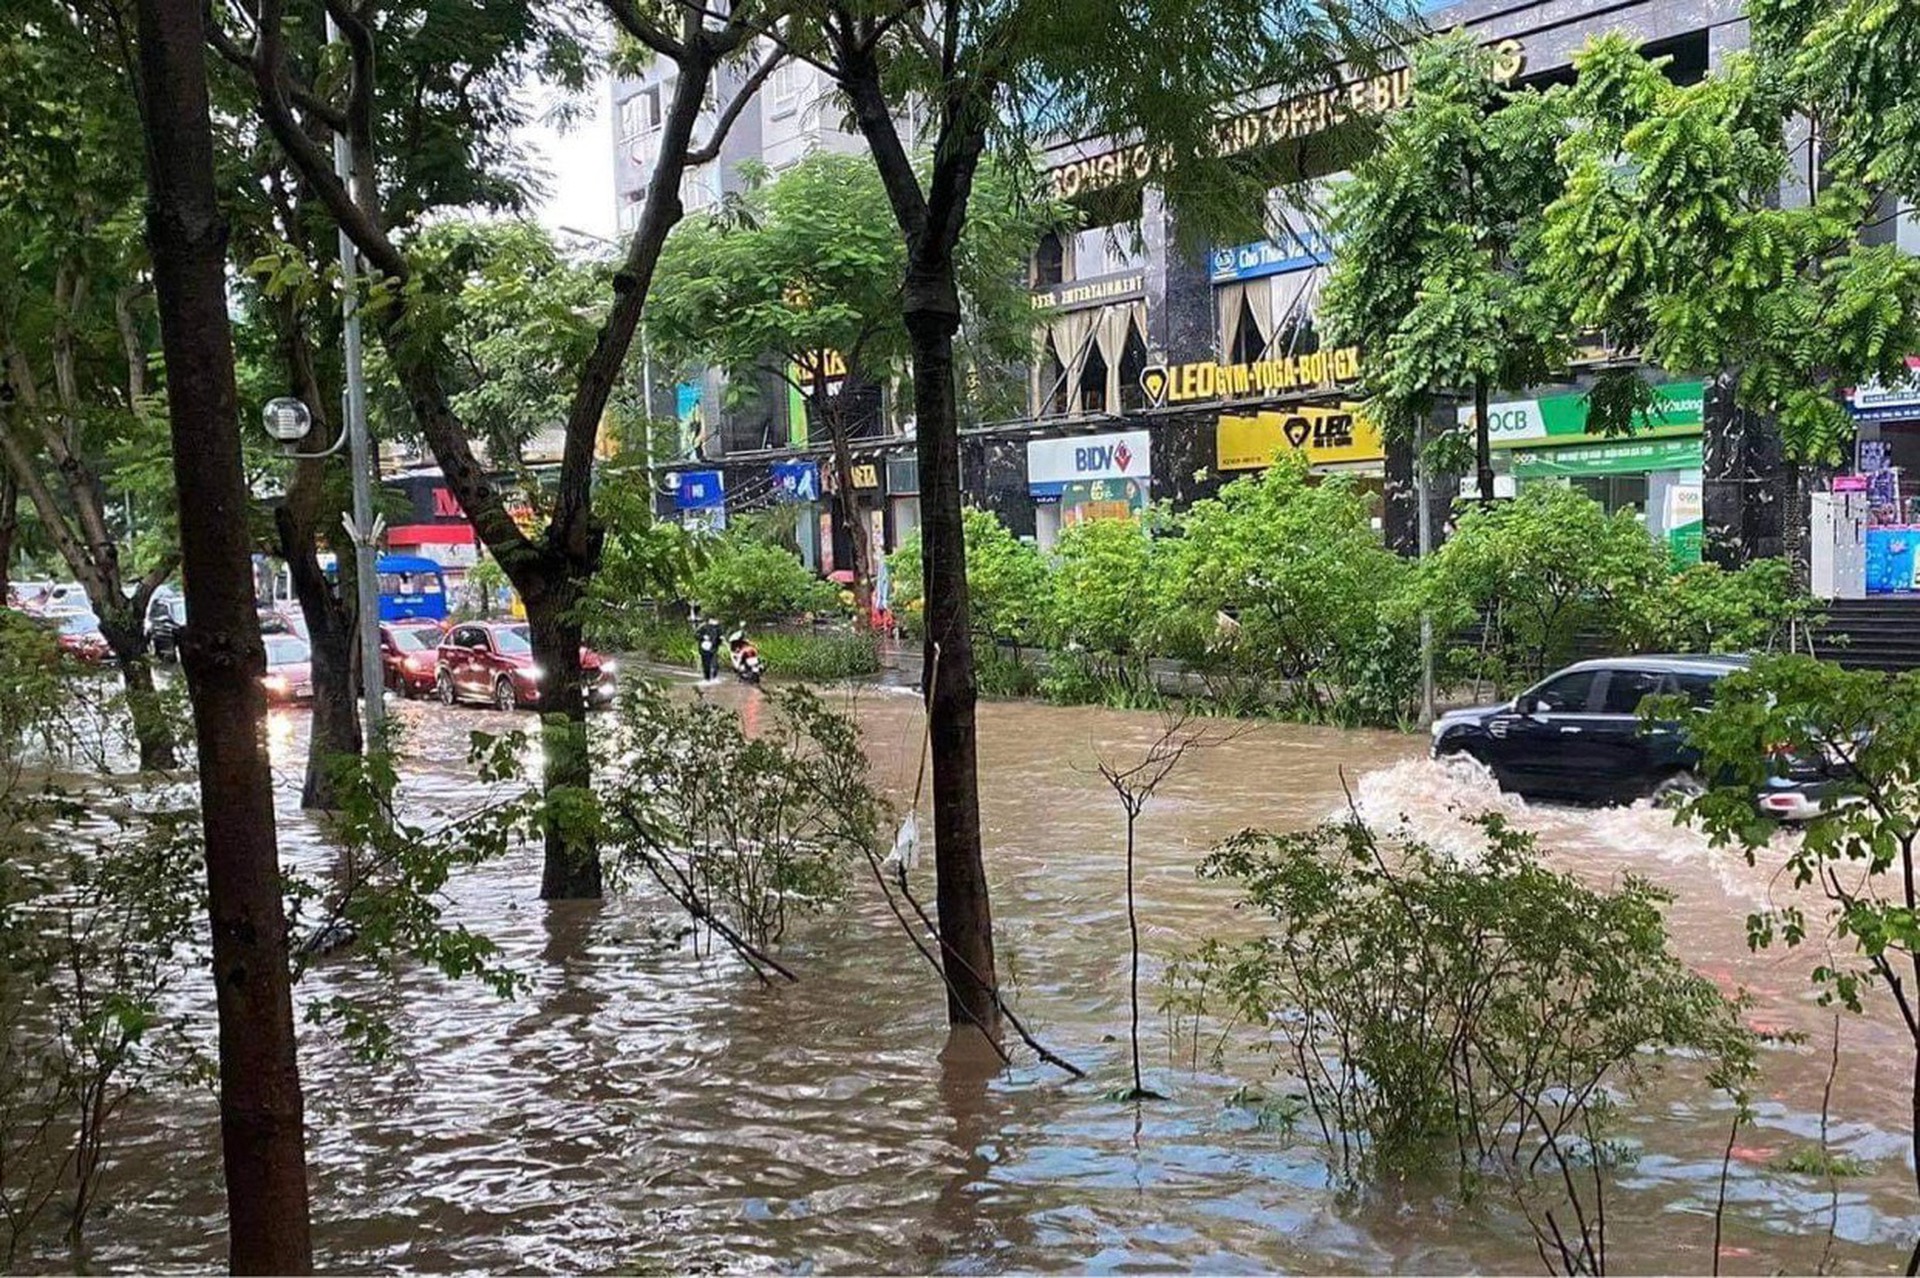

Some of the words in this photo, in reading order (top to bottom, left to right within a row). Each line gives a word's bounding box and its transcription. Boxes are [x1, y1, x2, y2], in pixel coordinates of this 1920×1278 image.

[1061, 275, 1143, 305] ENTERTAINMENT
[1168, 362, 1217, 401] LEO
[1487, 410, 1527, 433] OCB
[1075, 446, 1113, 471] BIDV
